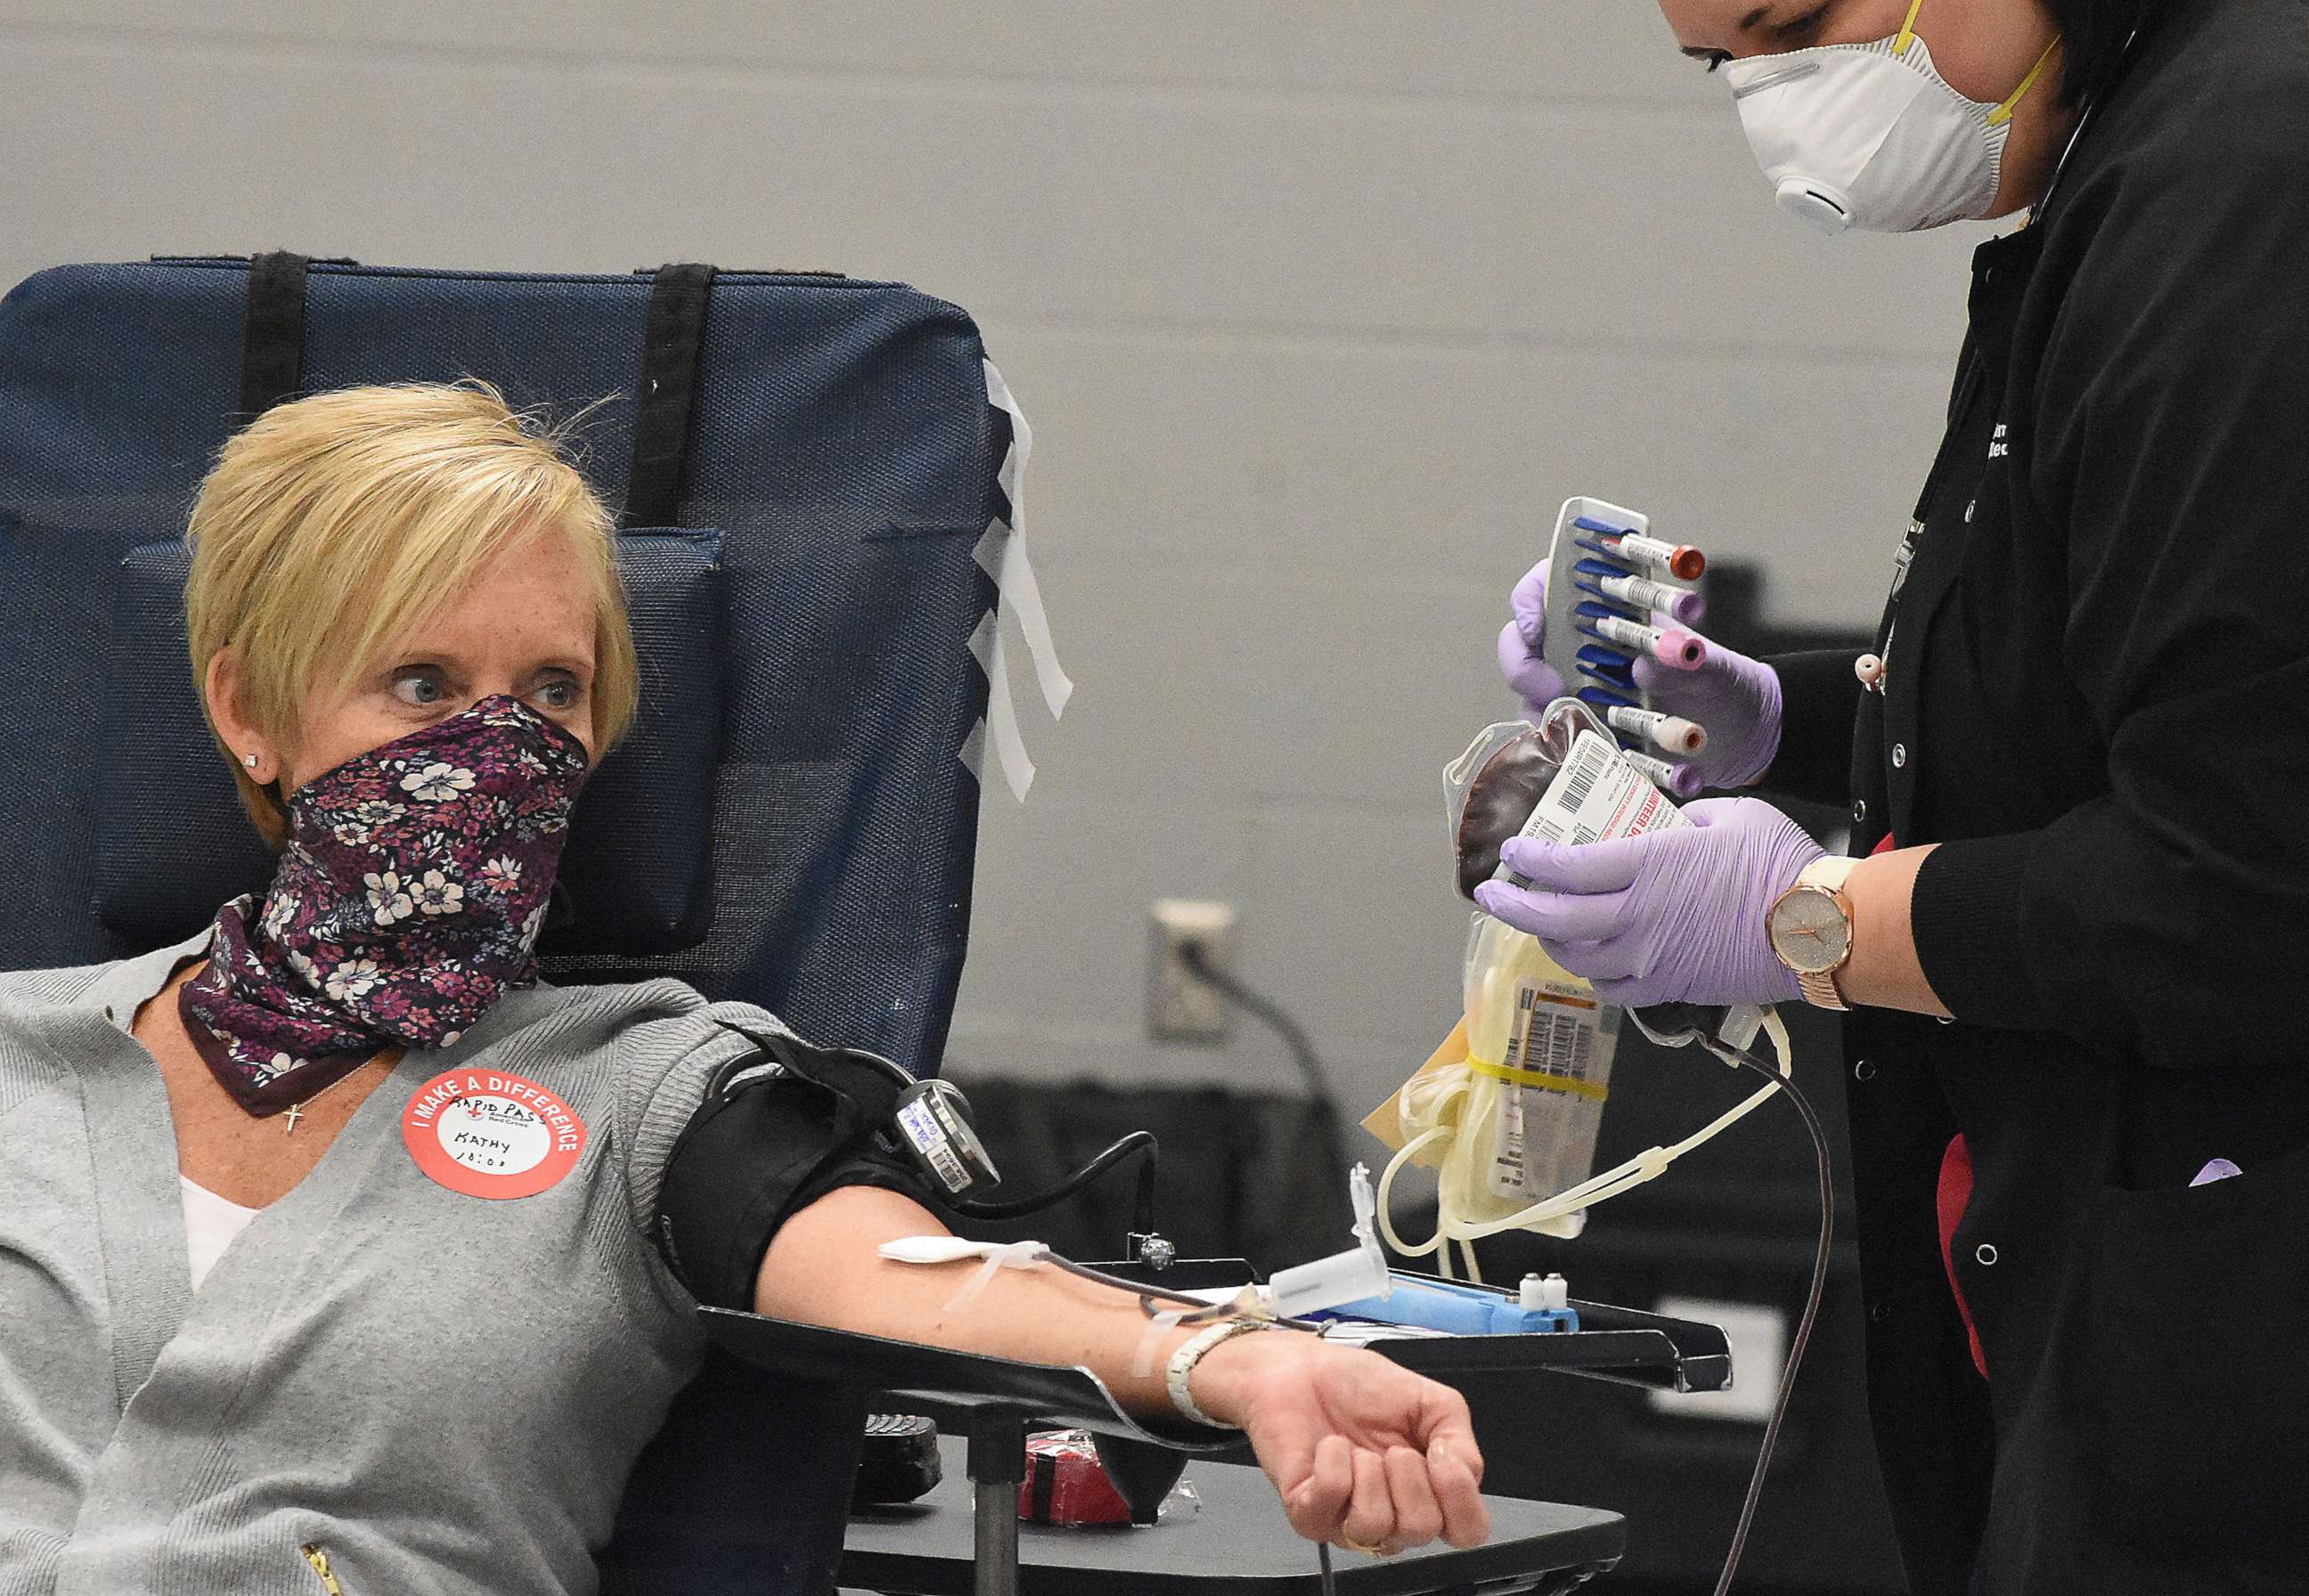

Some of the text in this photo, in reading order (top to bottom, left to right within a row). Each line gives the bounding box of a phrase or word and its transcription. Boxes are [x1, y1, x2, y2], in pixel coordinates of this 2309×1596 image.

[1635, 787, 1664, 828] LUNTEER
[412, 1079, 462, 1120] MAKE
[467, 1076, 482, 1091] A
[488, 1077, 579, 1152] DIFFERENCE
[449, 1095, 546, 1124] RAPID PASS
[505, 1119, 528, 1128] Cross
[454, 1132, 510, 1153] KATHY
